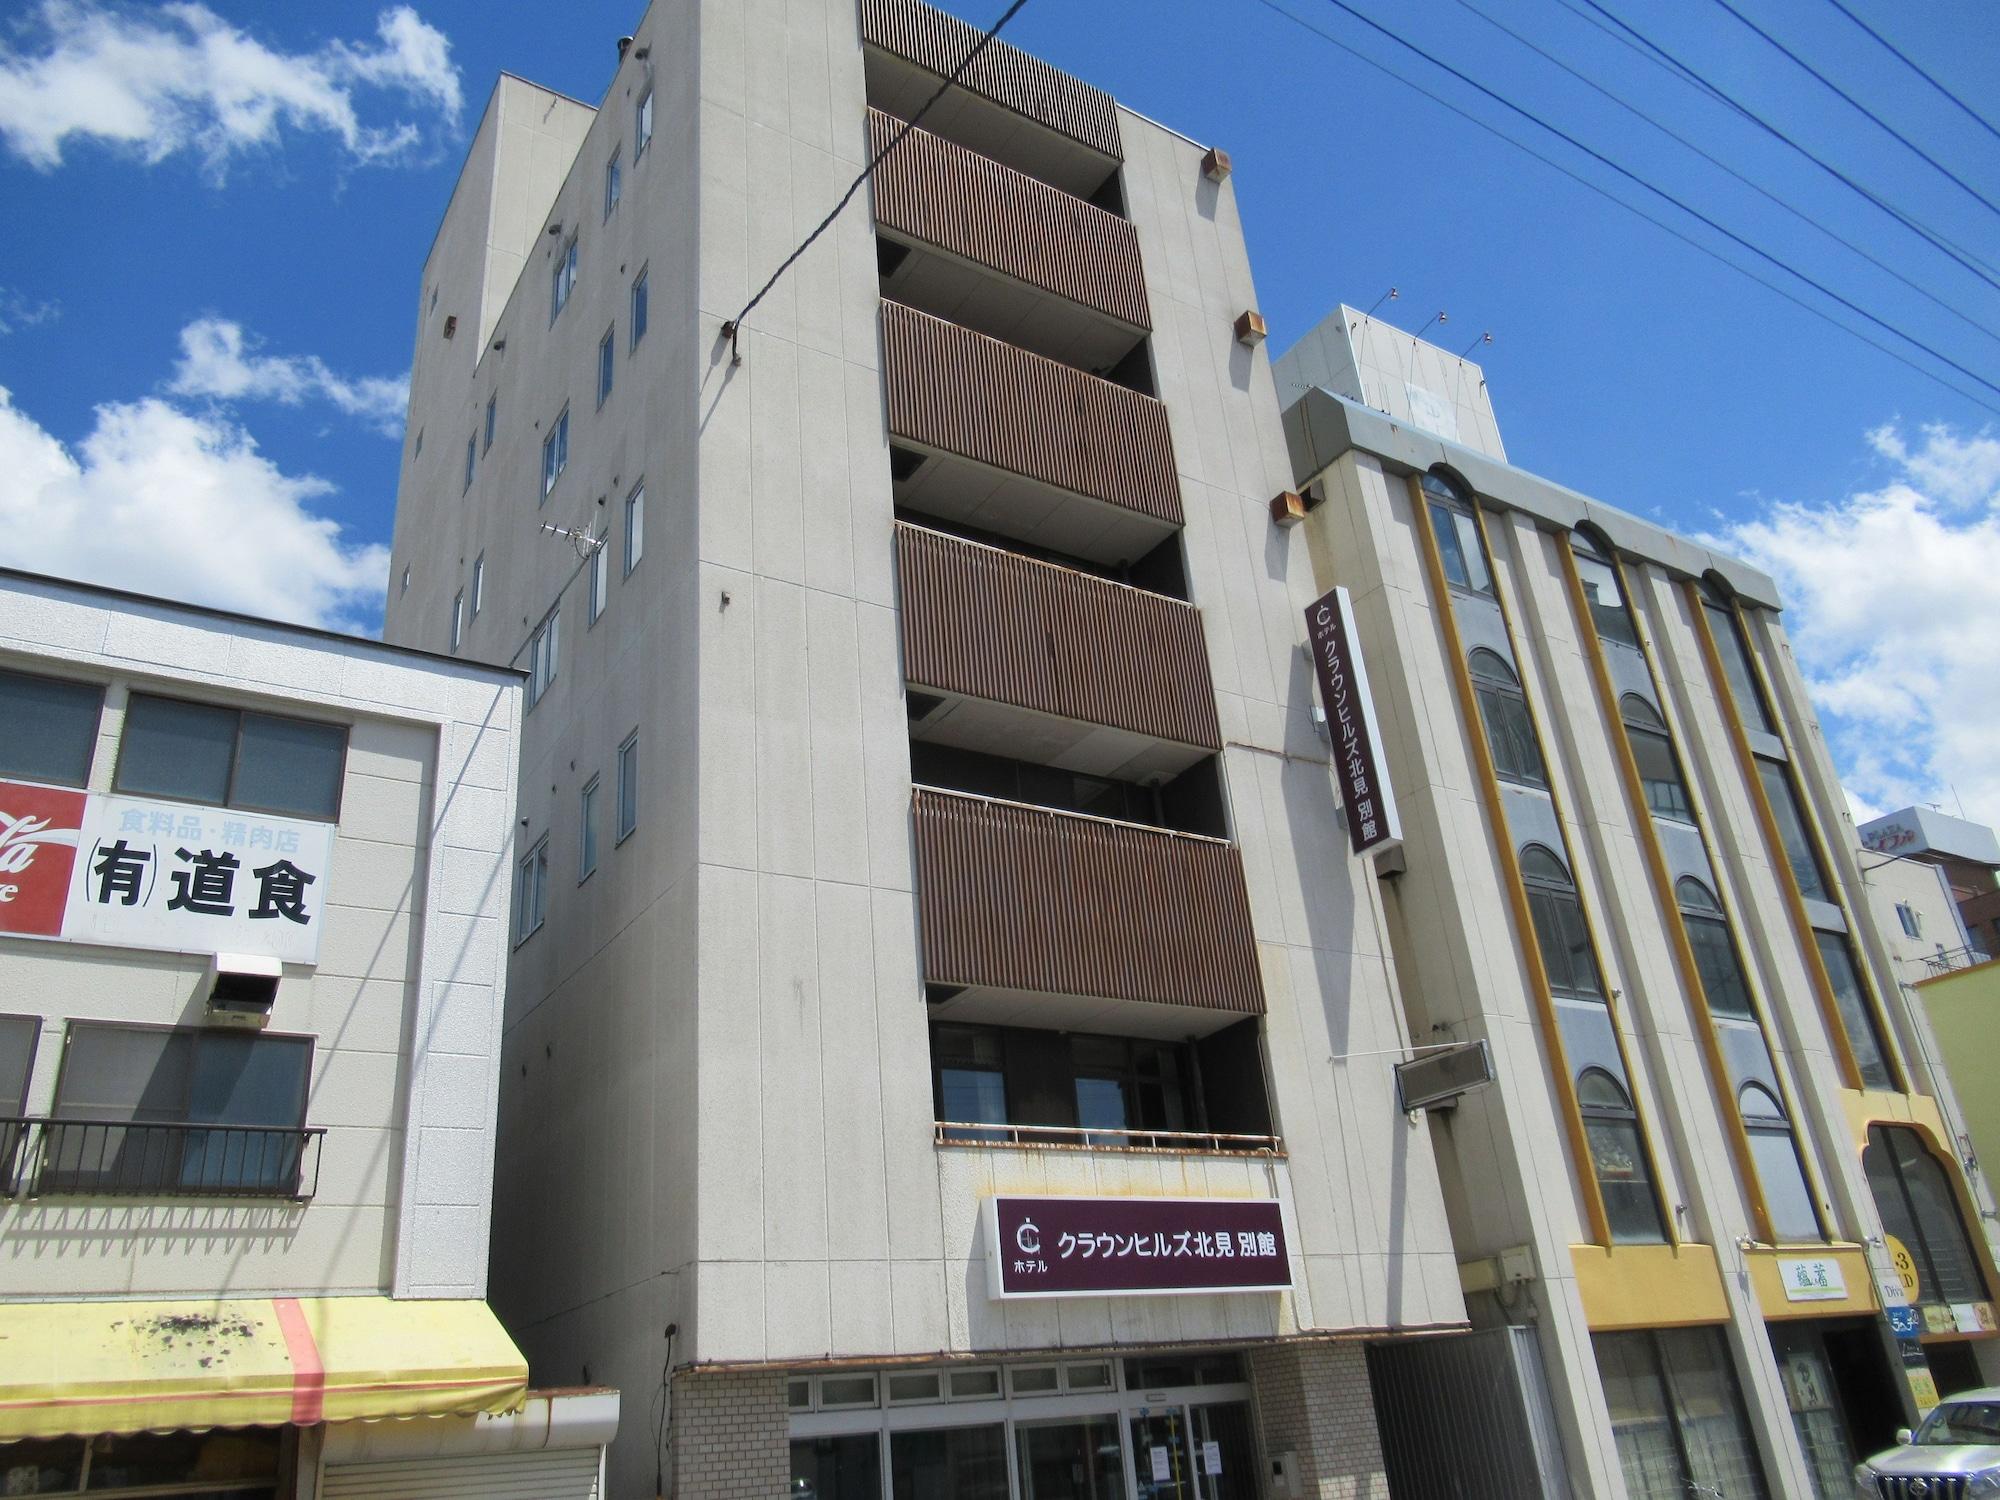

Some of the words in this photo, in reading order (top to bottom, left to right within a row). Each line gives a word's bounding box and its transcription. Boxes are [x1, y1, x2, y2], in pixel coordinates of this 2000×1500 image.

[1317, 623, 1337, 639] ホテル
[1323, 640, 1369, 800] クラウンヒルズ北見
[1357, 800, 1378, 841] 別館
[118, 808, 301, 852] 食料品・精肉店
[1057, 1231, 1234, 1259] クラウンヒルズ北見
[1238, 1231, 1278, 1257] 別館
[1014, 1259, 1048, 1274] ホテル
